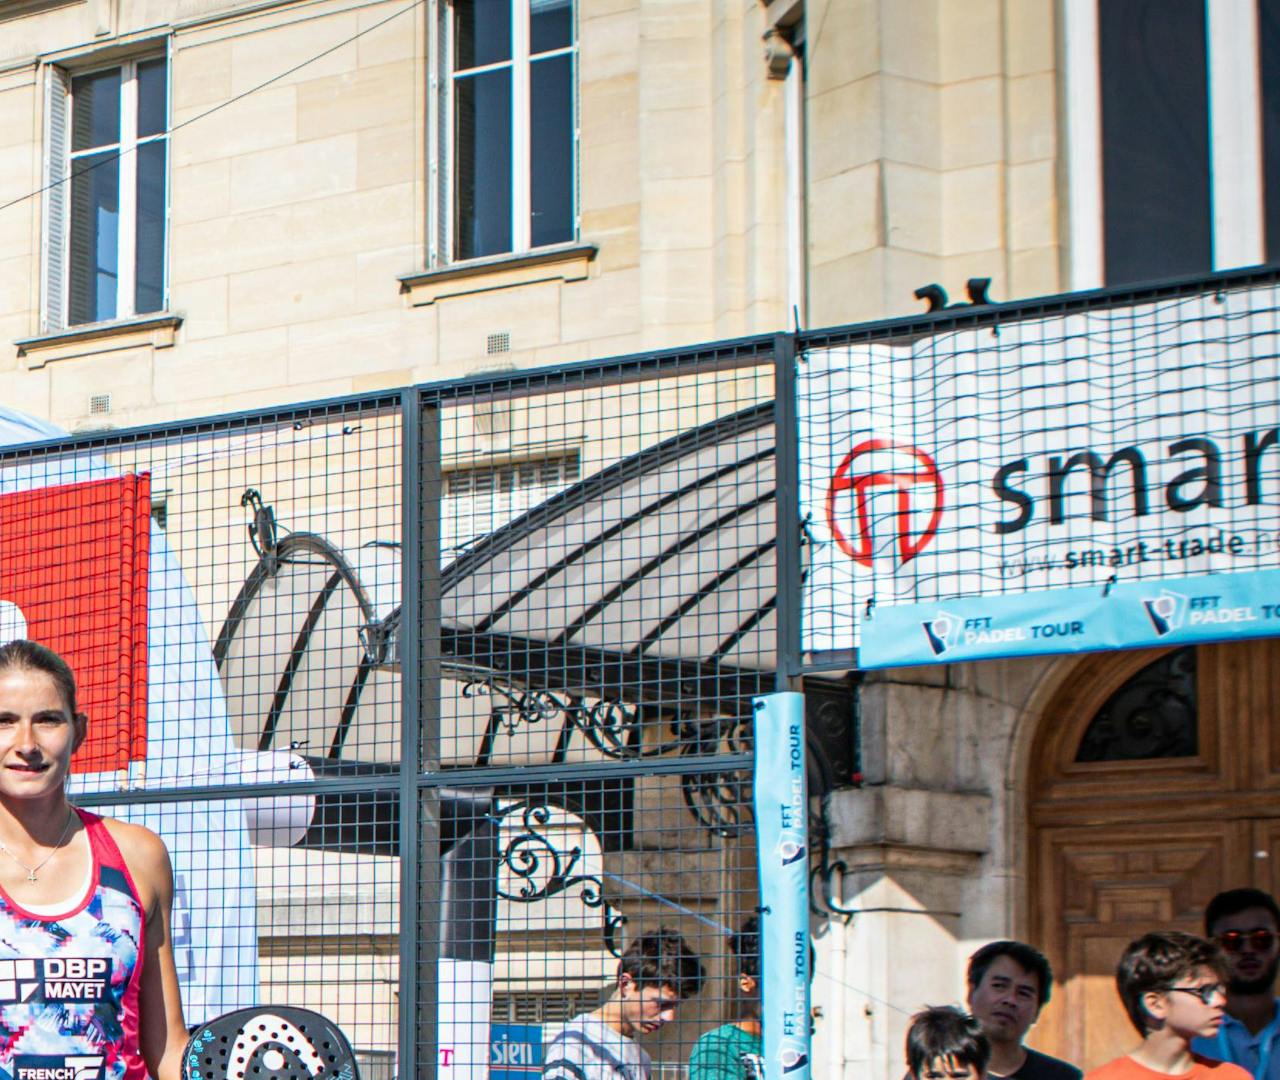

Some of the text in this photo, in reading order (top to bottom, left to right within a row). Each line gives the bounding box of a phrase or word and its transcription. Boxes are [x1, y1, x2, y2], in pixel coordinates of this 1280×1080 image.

[1188, 595, 1222, 609] FFT
[964, 616, 992, 630] FFT
[1189, 607, 1258, 625] PADEL
[964, 620, 1084, 645] PADEL TOUR
[790, 724, 803, 829] PADEL TOUR
[781, 803, 792, 829] FFT
[44, 959, 106, 979] DBP
[45, 983, 104, 999] MAYET
[795, 931, 806, 1036] PADEL TOUR
[784, 1011, 794, 1036] FFT
[18, 1068, 74, 1080] FRENCH
